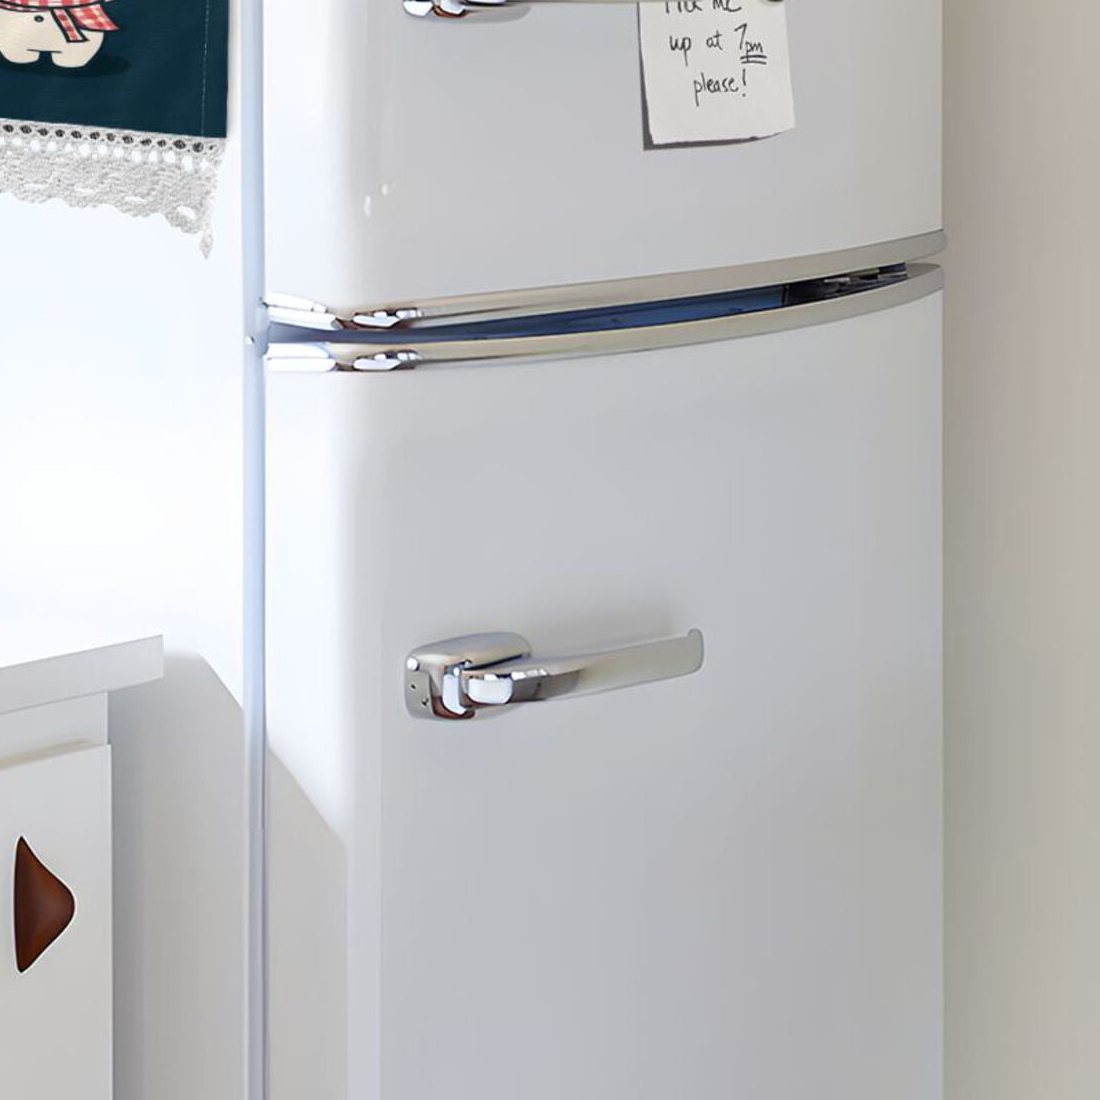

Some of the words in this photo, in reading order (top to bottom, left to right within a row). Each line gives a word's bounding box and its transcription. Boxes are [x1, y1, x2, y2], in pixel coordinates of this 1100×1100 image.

[669, 35, 692, 67] up
[706, 30, 723, 51] at
[693, 68, 747, 107] please!
